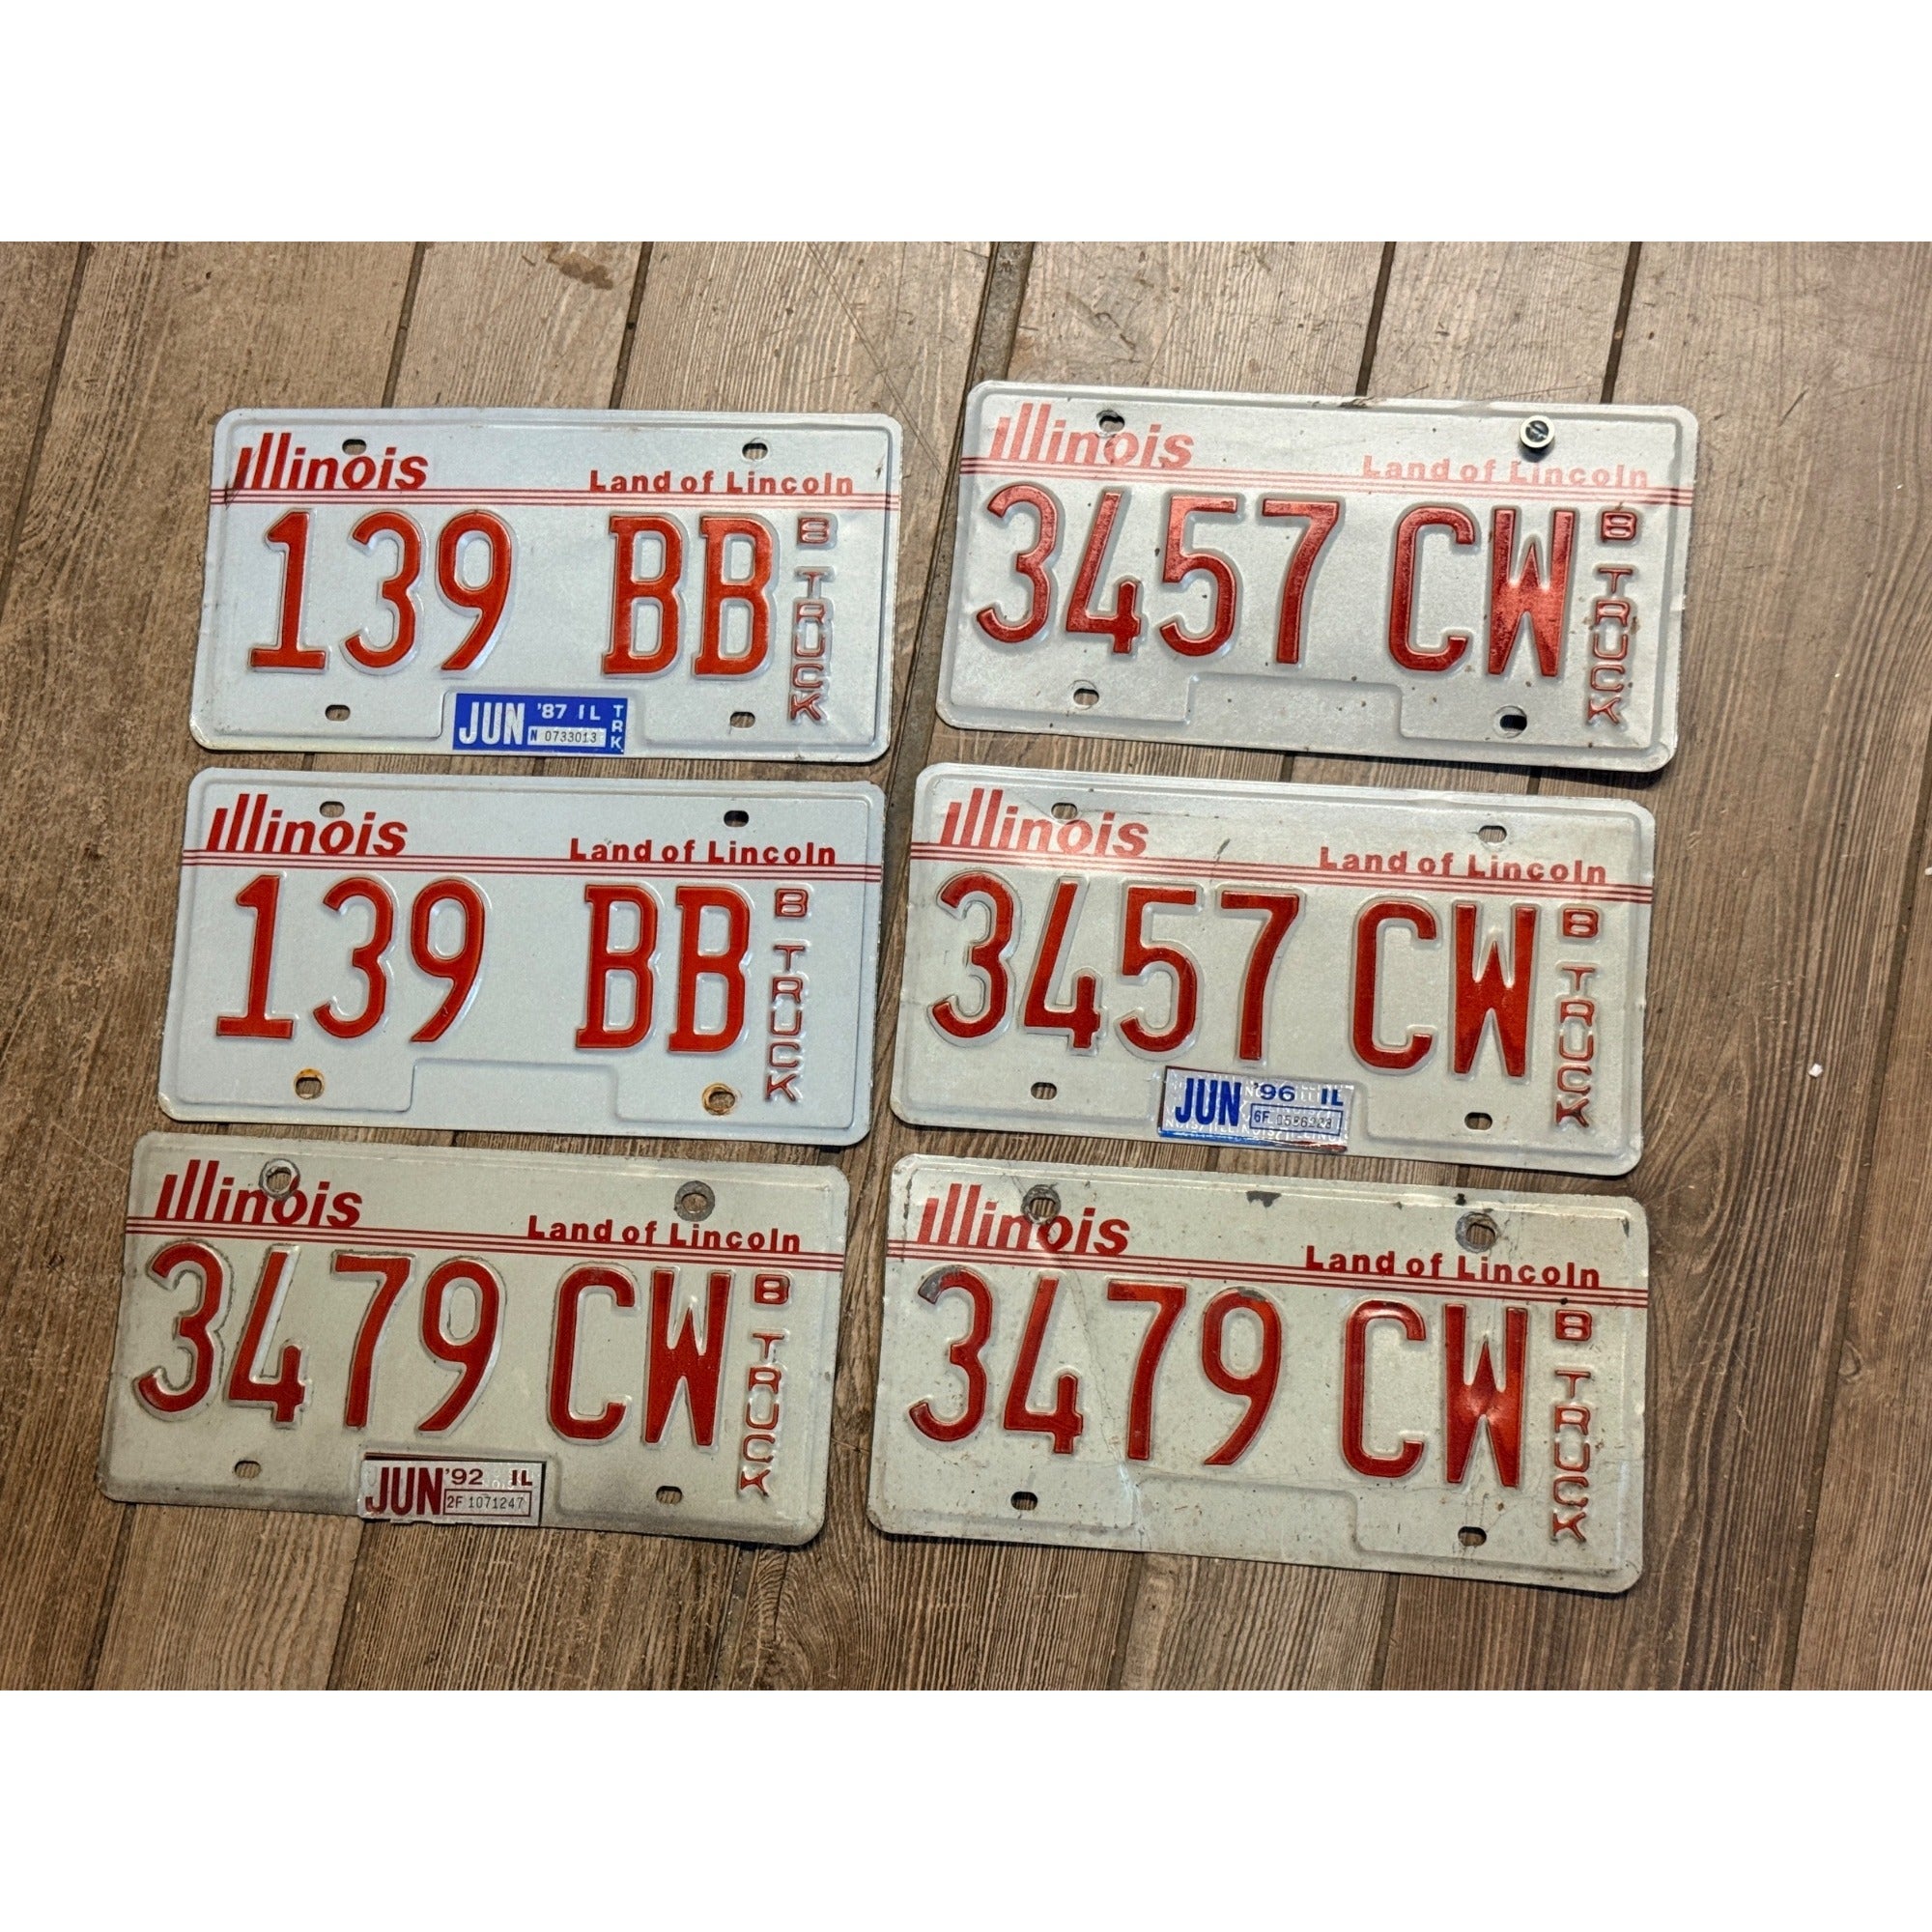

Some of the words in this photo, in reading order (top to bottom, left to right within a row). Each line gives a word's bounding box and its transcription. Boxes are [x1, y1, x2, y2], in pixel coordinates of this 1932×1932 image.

[232, 433, 428, 491] Illinois
[989, 403, 1194, 470] Illinois
[590, 469, 670, 494] Land
[680, 470, 714, 495] of
[726, 471, 854, 496] Lincoln
[1362, 455, 1450, 481] Land
[1460, 459, 1496, 483] of
[1510, 461, 1648, 489] Lincoln
[798, 517, 830, 544] B
[1602, 511, 1637, 541] B
[251, 510, 512, 670] 139
[603, 514, 773, 676] BB
[976, 484, 1340, 665] 3457
[1388, 506, 1576, 676] CW
[789, 568, 828, 721] TRUCK
[1588, 567, 1633, 724] TRUCK
[459, 701, 526, 745] JUN
[537, 703, 567, 719] '87
[545, 730, 597, 743] 0733013
[207, 793, 408, 857] Illinois
[939, 788, 1150, 859] Illinois
[569, 838, 652, 863] Land
[662, 839, 696, 864] of
[708, 840, 836, 867] Lincoln
[1320, 846, 1407, 874] Land
[1417, 852, 1454, 877] of
[1466, 854, 1605, 885] Lincoln
[775, 888, 808, 918] B
[1562, 908, 1599, 938] B
[216, 873, 485, 1042] 139
[576, 884, 751, 1053] BB
[931, 872, 1300, 1061] 3457
[1352, 899, 1537, 1077] CW
[765, 944, 806, 1101] TRUCK
[1556, 966, 1595, 1127] TRUCK
[1175, 1077, 1241, 1126] JUN
[1254, 1083, 1295, 1102] '96
[1321, 1088, 1344, 1106] IL
[1254, 1110, 1270, 1123] 6F
[155, 1159, 362, 1228] Illinois
[918, 1183, 1130, 1256] Illinois
[527, 1215, 612, 1242] Land
[621, 1221, 657, 1245] of
[669, 1223, 800, 1253] Lincoln
[753, 1272, 790, 1304] B
[1305, 1245, 1395, 1275] Land
[1406, 1253, 1442, 1279] of
[1457, 1255, 1600, 1289] Lincoln
[132, 1240, 499, 1432] 3479
[550, 1266, 731, 1446] CW
[1555, 1309, 1592, 1342] B
[909, 1265, 1282, 1465] 3479
[1342, 1300, 1529, 1488] CW
[739, 1332, 785, 1497] TRUCK
[1552, 1369, 1591, 1543] TRUCK
[365, 1466, 443, 1516] JUN
[445, 1468, 483, 1485] '92
[512, 1469, 532, 1486] IL
[446, 1495, 464, 1509] 2F
[469, 1496, 525, 1510] 1071247
